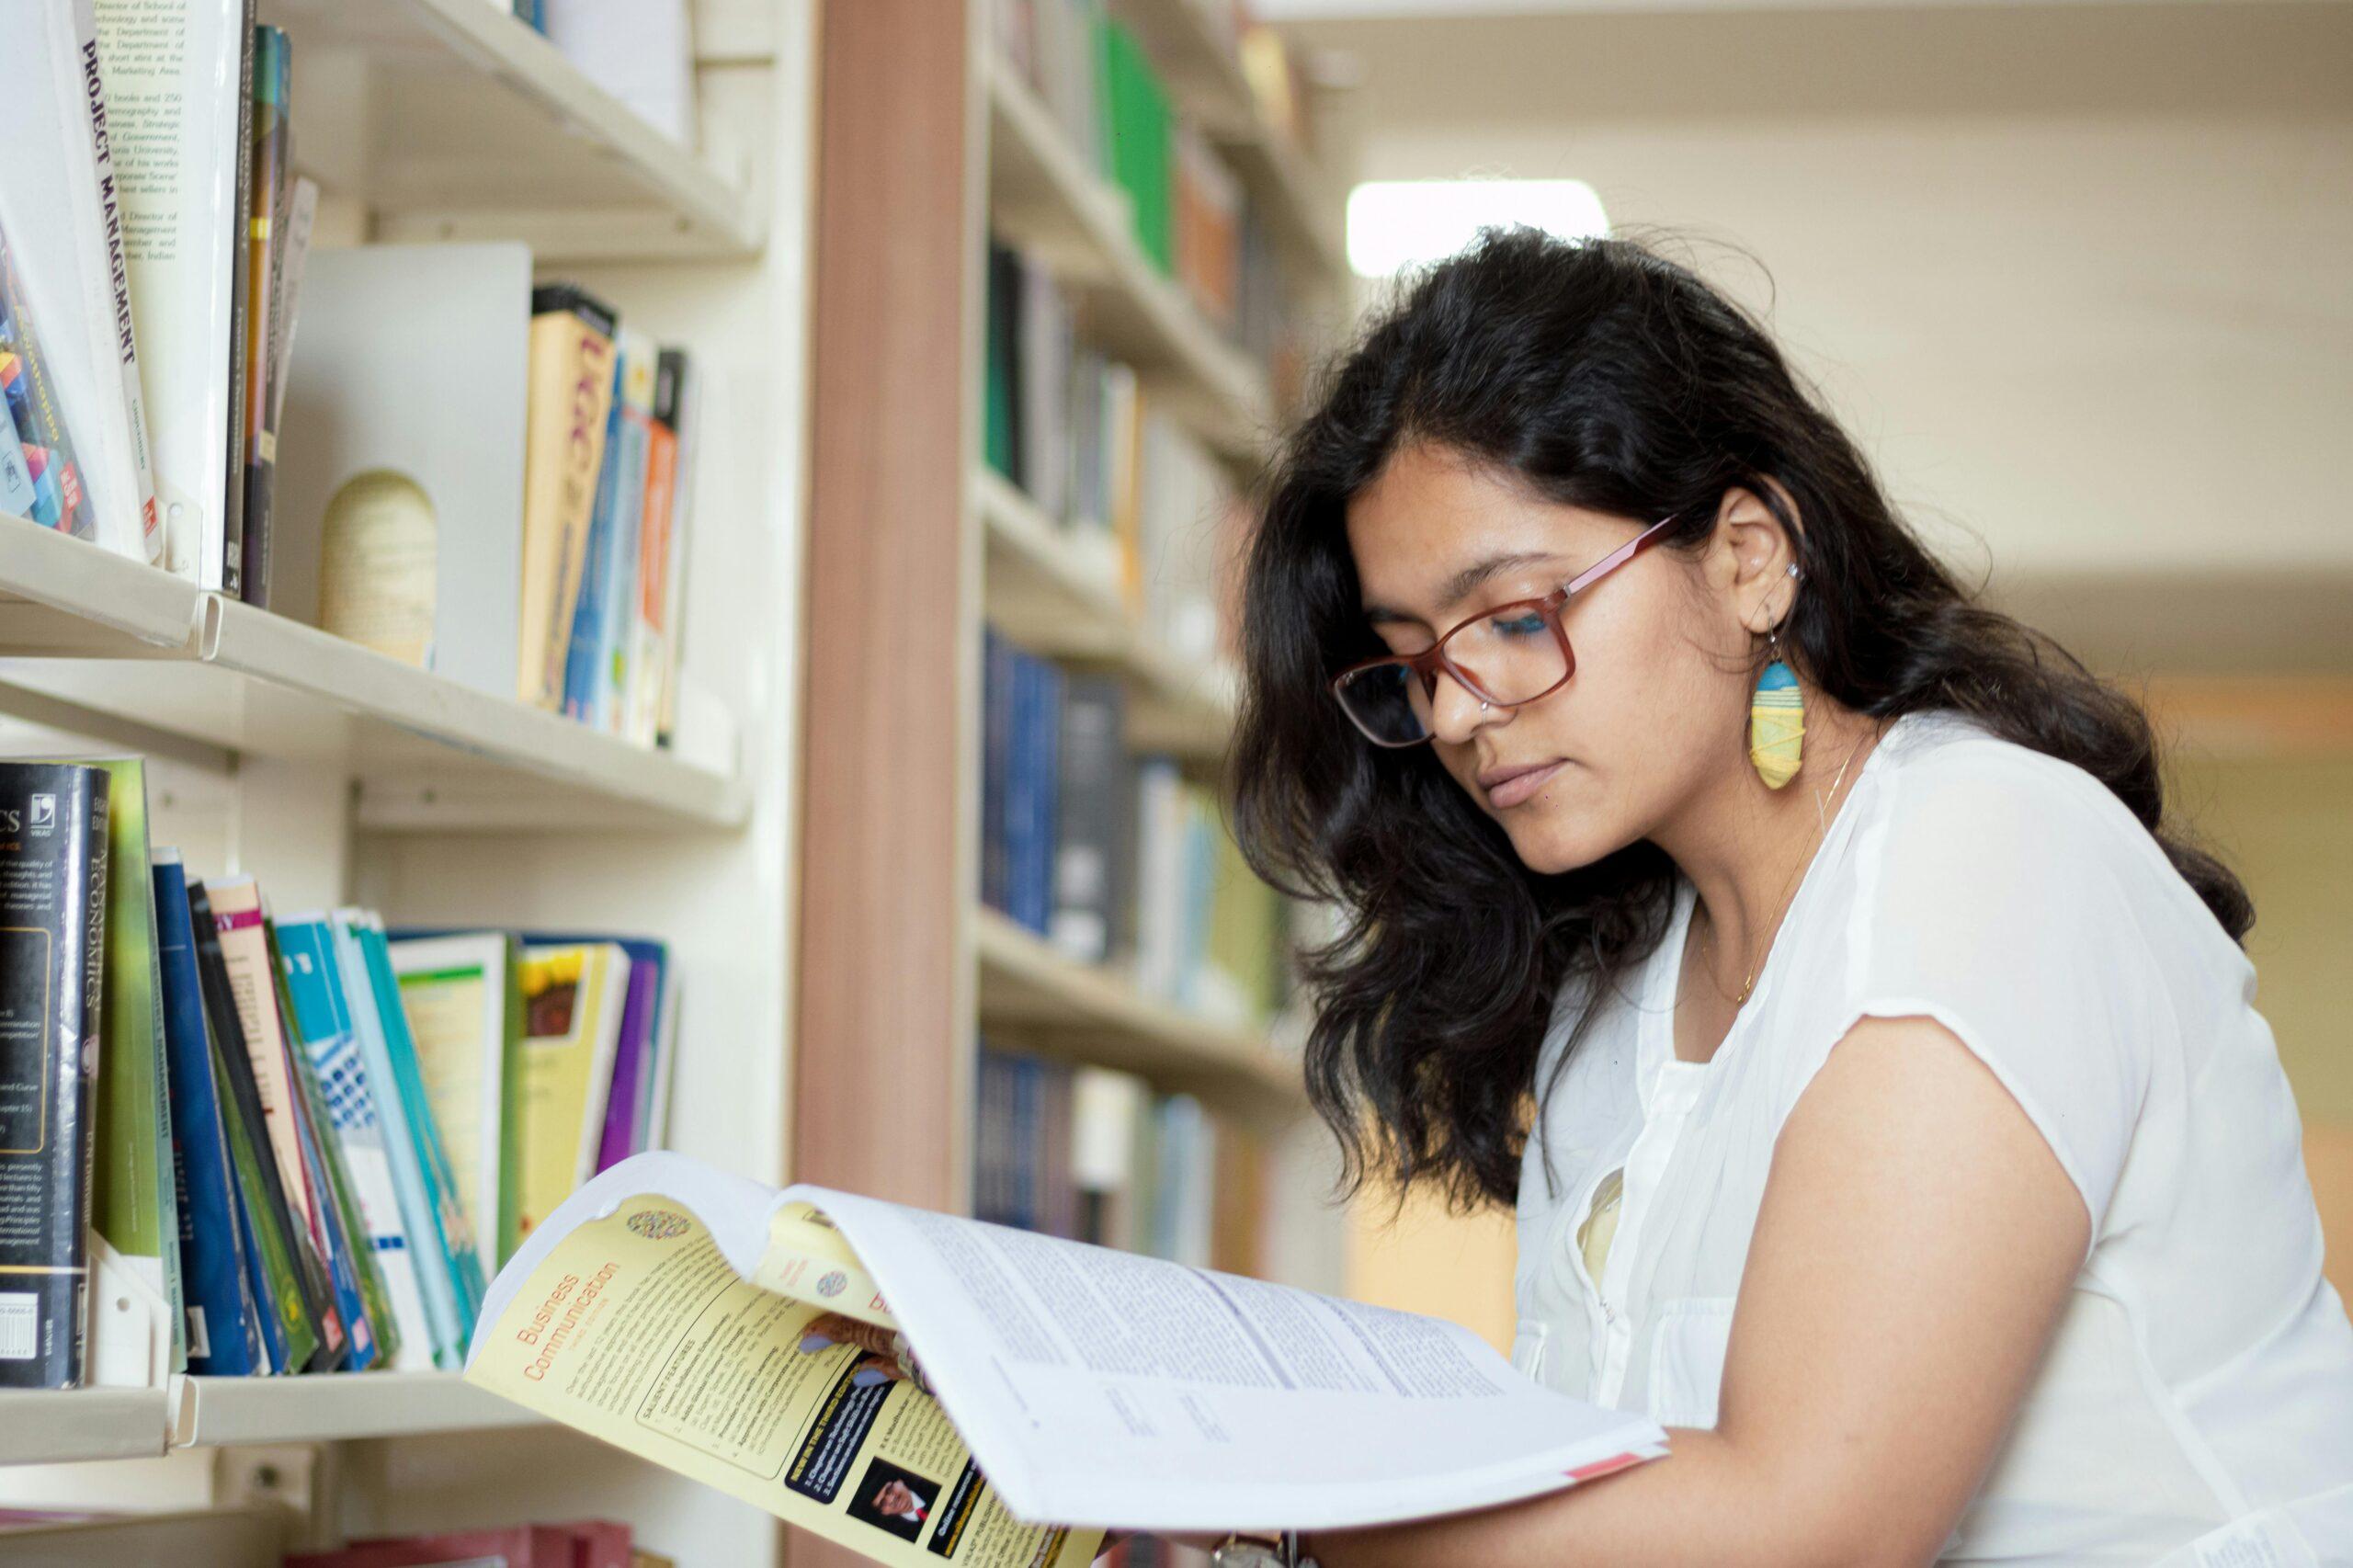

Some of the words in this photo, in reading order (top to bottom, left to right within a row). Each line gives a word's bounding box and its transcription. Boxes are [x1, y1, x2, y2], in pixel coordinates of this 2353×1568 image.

[83, 39, 110, 164] PROJECT
[101, 174, 135, 366] MANAGEMENT
[241, 98, 253, 250] ENVIRONMENT
[30, 829, 51, 837] VIKAS
[86, 856, 100, 1009] ECONOMICS
[153, 1036, 170, 1139] MANAGEMENT
[516, 1274, 580, 1346] Business
[524, 1261, 620, 1381] Communication
[640, 1381, 670, 1420] SALIENT
[664, 1336, 696, 1381] FEATURES
[659, 1388, 679, 1414] Covers
[679, 1402, 695, 1422] Adds
[689, 1378, 710, 1403] Global
[704, 1351, 725, 1379] Flavour
[716, 1405, 741, 1438] Provides
[744, 1375, 757, 1392] with
[755, 1398, 768, 1415] with
[765, 1361, 790, 1398] Corporate
[790, 1456, 808, 1483] NEW
[801, 1444, 814, 1459] IN
[808, 1425, 824, 1447] THE
[818, 1397, 839, 1427] THIRD
[834, 1359, 862, 1401] EDITION
[823, 1437, 834, 1450] on
[827, 1398, 857, 1439] Technology
[837, 1427, 851, 1445] Soft
[845, 1407, 861, 1430] Skills
[807, 1449, 829, 1481] Chapter
[816, 1454, 838, 1485] Chapter
[825, 1457, 847, 1488] Sections
[833, 1443, 843, 1455] on
[936, 1506, 957, 1537] Online
[949, 1469, 975, 1508] resources
